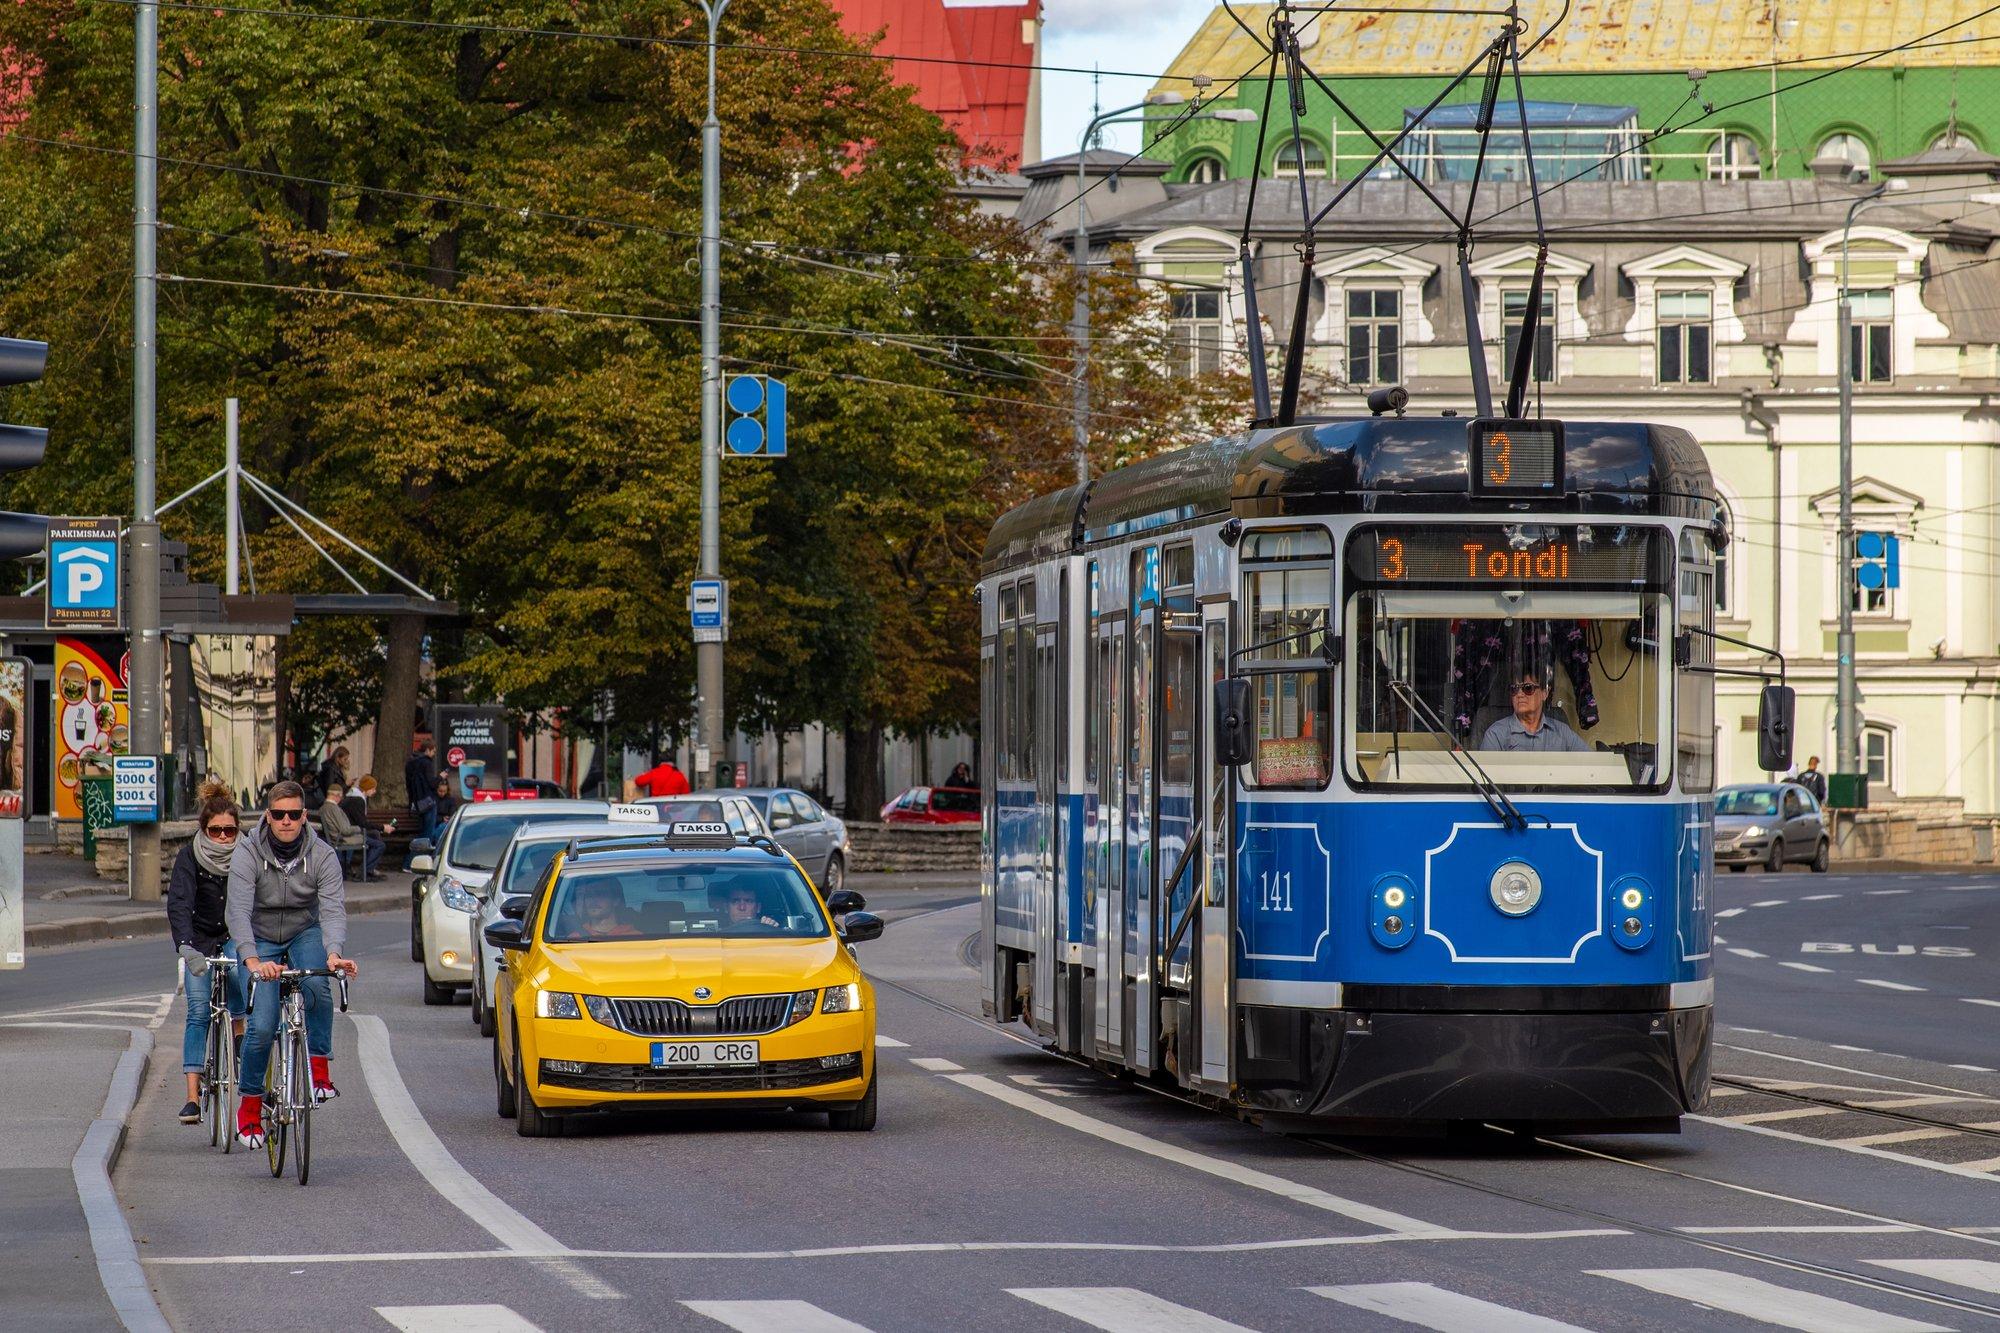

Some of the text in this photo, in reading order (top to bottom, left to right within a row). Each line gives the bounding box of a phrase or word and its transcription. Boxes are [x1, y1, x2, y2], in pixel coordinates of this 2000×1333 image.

[1489, 433, 1512, 485] 3
[51, 529, 116, 538] PARKIMISMAJA
[1382, 538, 1569, 579] 3 Tondi
[68, 563, 103, 604] P
[56, 609, 80, 618] Pärnu
[101, 609, 111, 618] 22
[453, 728, 490, 737] OOTAME
[448, 736, 495, 745] AVASTAMA
[115, 774, 156, 784] 3000 €
[116, 791, 156, 800] 3001 €
[617, 807, 651, 816] TAKSO
[679, 824, 722, 832] TAKSO
[1260, 870, 1293, 912] 141
[1801, 942, 1976, 957] BUS
[668, 1044, 753, 1062] 200 CRG
